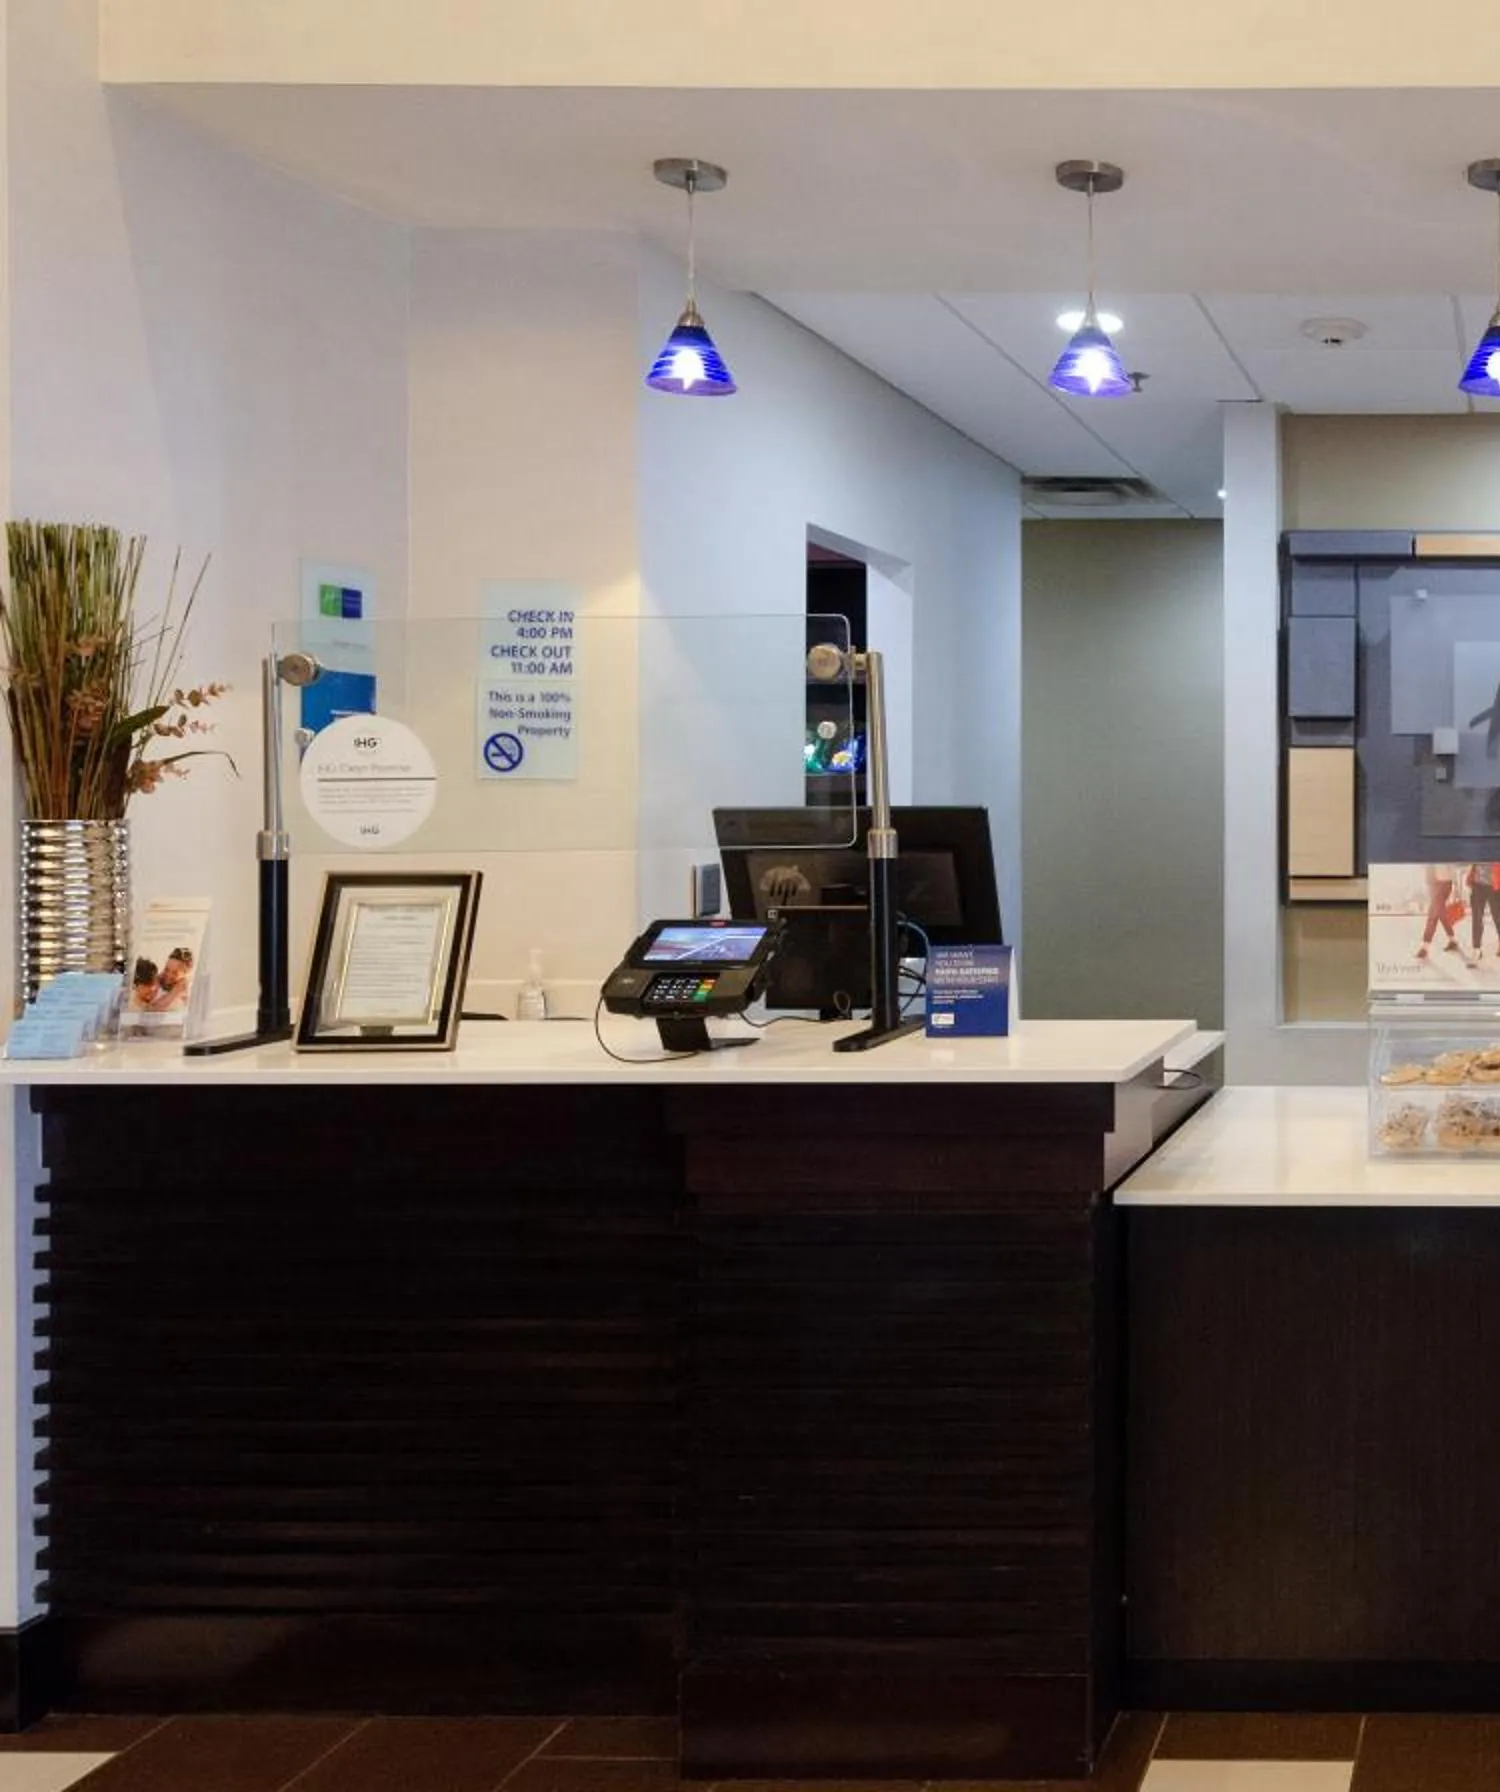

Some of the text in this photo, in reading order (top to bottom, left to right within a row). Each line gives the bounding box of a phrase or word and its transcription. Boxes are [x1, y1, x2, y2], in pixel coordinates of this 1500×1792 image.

[507, 610, 575, 623] CHECK IN
[516, 627, 573, 640] 4:00 PM
[490, 645, 573, 658] CHECK OUT
[510, 662, 573, 675] 11:00 AM
[488, 690, 572, 703] This is a 100%
[488, 707, 572, 722] Non-Smoking
[516, 725, 571, 739] Property
